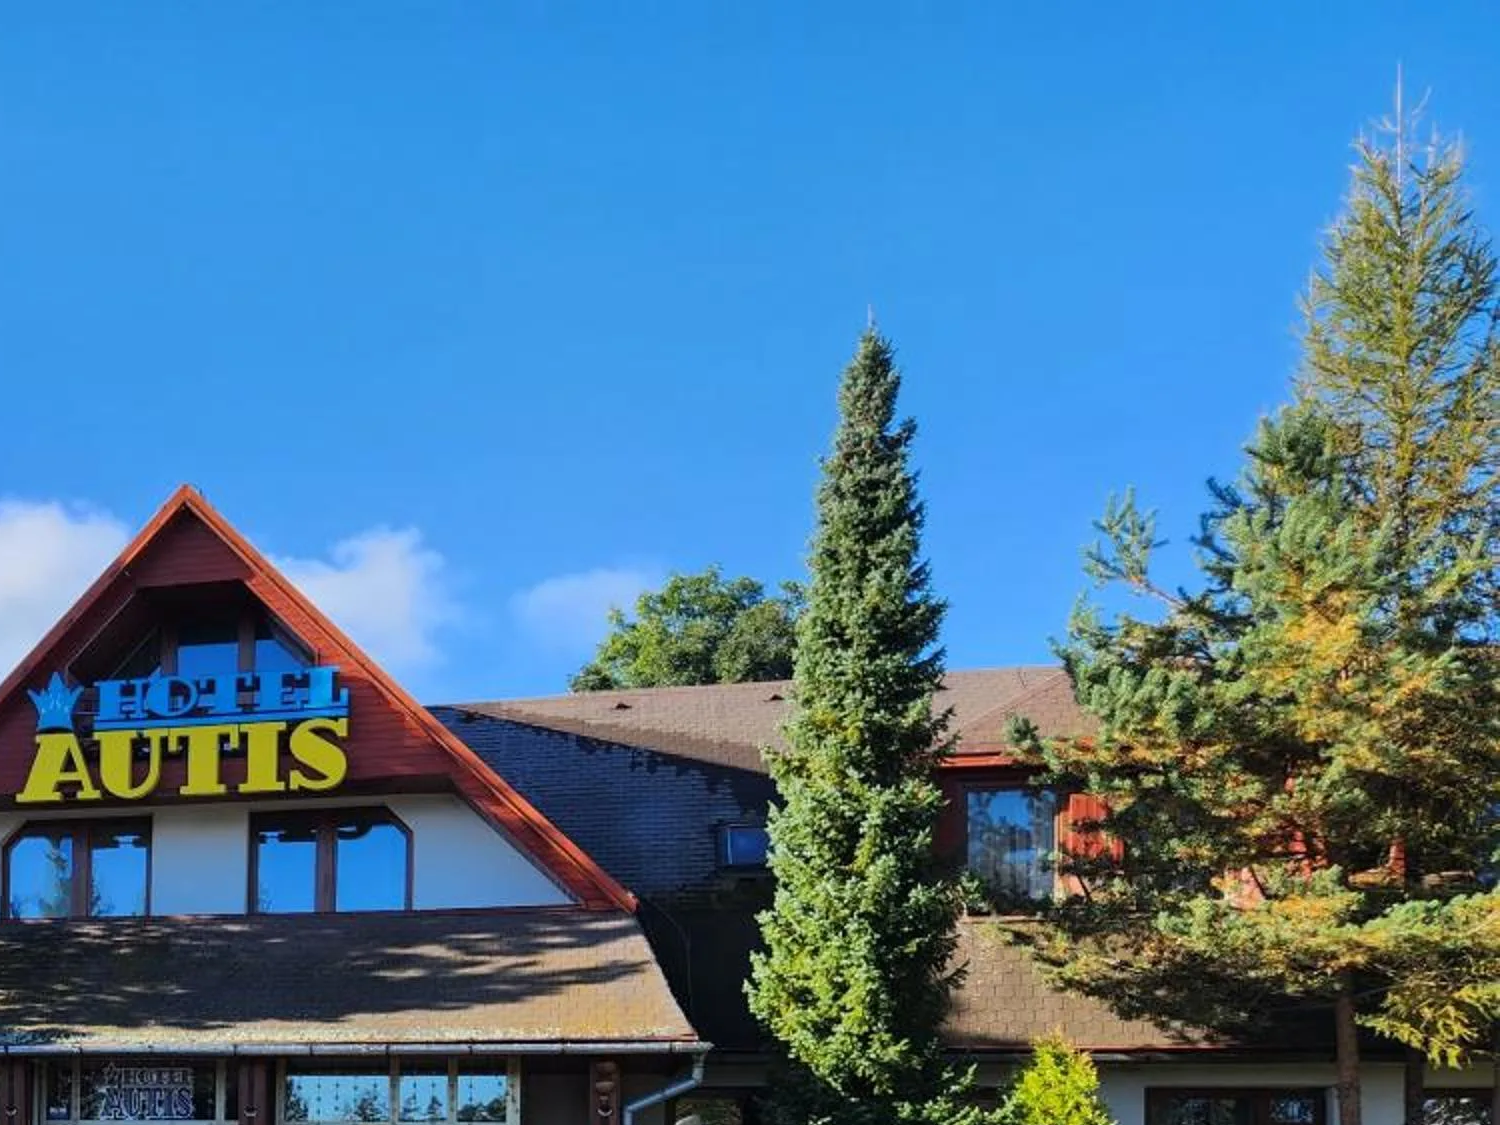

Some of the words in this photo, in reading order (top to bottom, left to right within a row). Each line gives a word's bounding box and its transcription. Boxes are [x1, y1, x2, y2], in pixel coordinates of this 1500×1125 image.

[93, 667, 350, 720] HOTEL
[15, 718, 348, 803] AUTIS
[100, 1086, 193, 1120] AUTIS
